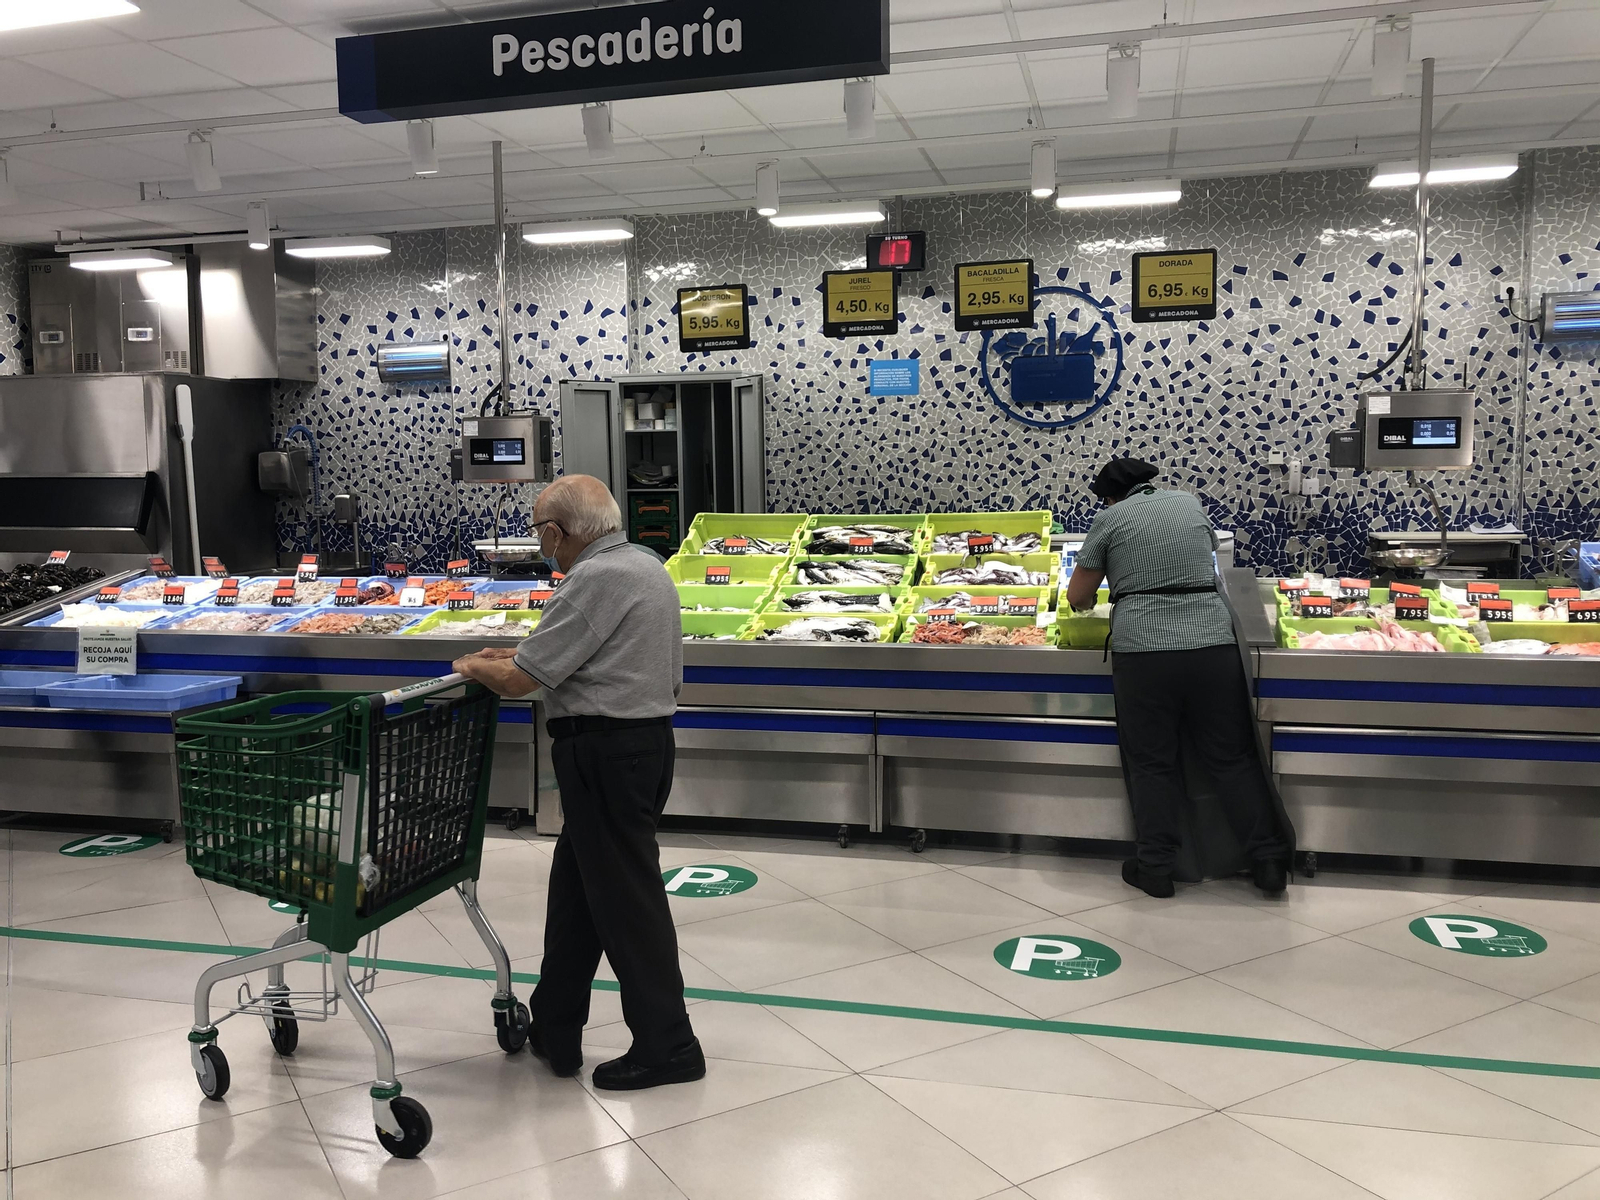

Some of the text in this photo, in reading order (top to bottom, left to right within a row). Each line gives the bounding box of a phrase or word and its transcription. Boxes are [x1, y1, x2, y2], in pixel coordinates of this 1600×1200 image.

[492, 6, 742, 76] Pescadería
[890, 240, 911, 263] 17
[1158, 260, 1193, 268] DORADA
[967, 267, 1020, 277] BACALADILLA
[1192, 286, 1208, 298] Kg
[1008, 294, 1024, 305] Kg
[875, 302, 890, 313] Kg
[726, 318, 740, 329] Kg
[114, 645, 132, 654] AQUÍ
[62, 834, 142, 852] P
[665, 866, 729, 892] P
[1424, 917, 1498, 949] P
[1010, 937, 1082, 971] P
